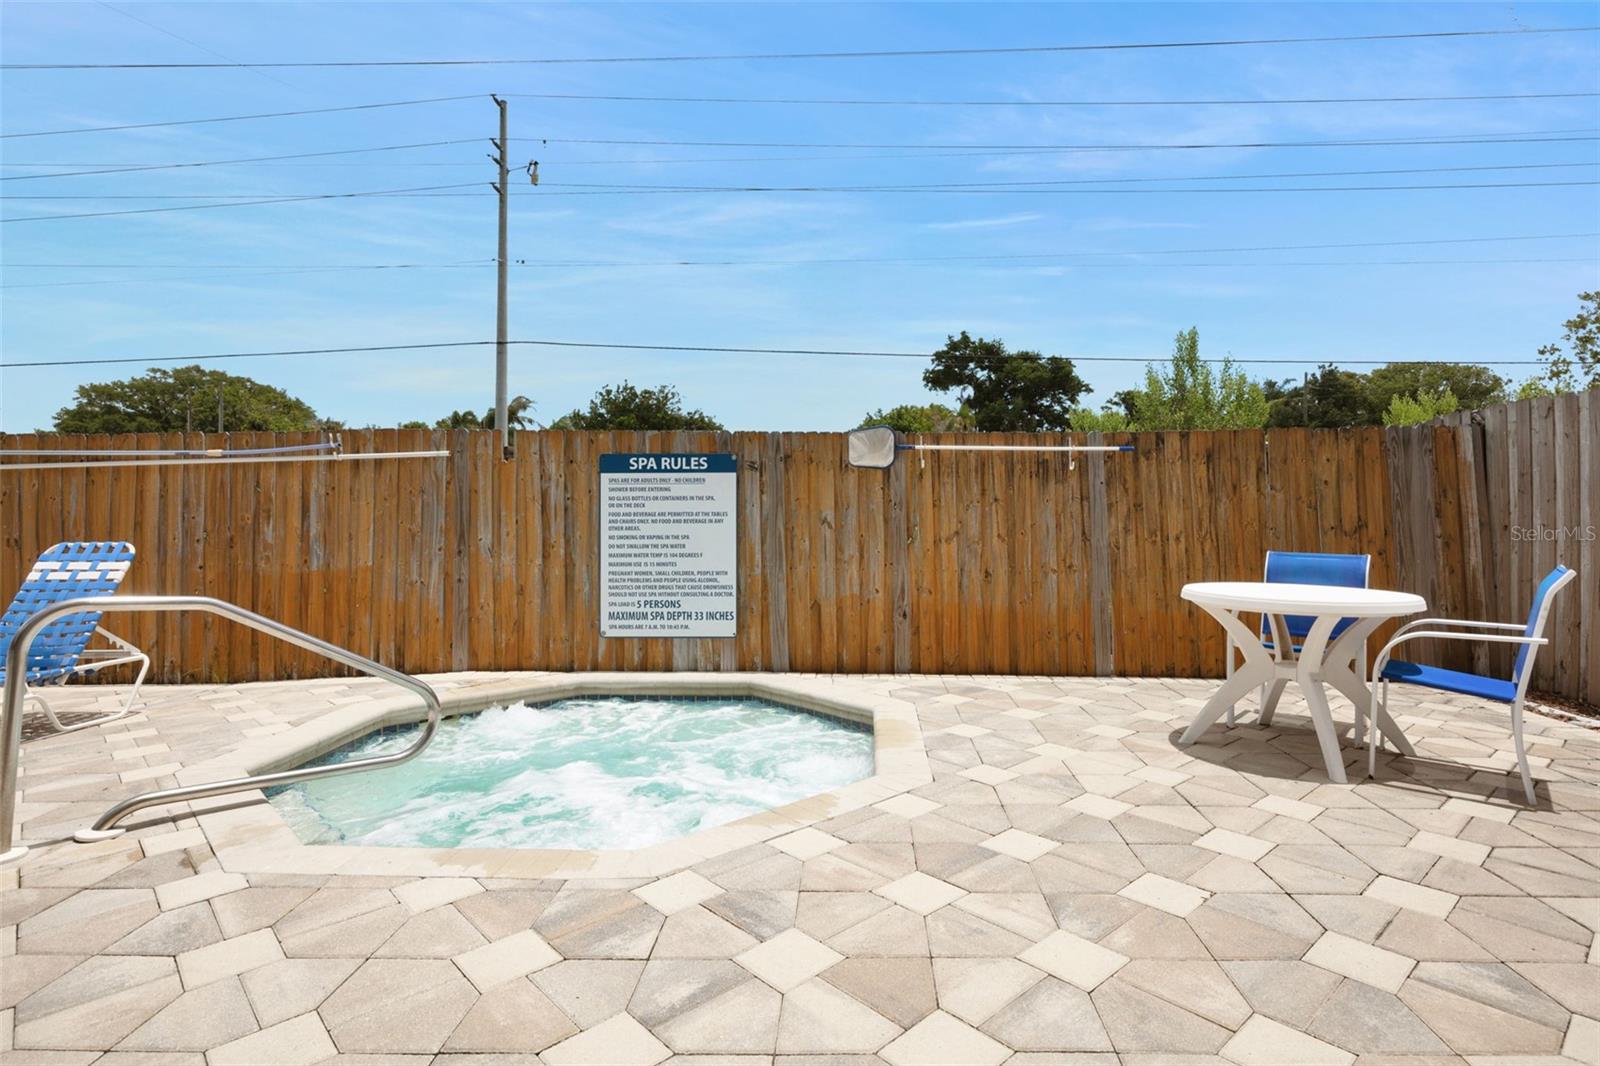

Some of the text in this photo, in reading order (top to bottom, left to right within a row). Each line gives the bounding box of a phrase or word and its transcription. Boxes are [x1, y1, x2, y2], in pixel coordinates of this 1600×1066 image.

[629, 457, 708, 470] SPA RULES
[637, 600, 641, 608] 5
[644, 600, 681, 608] PERSONS
[608, 611, 734, 620] MAXIMUM SPA DEPTH 33 INCHES
